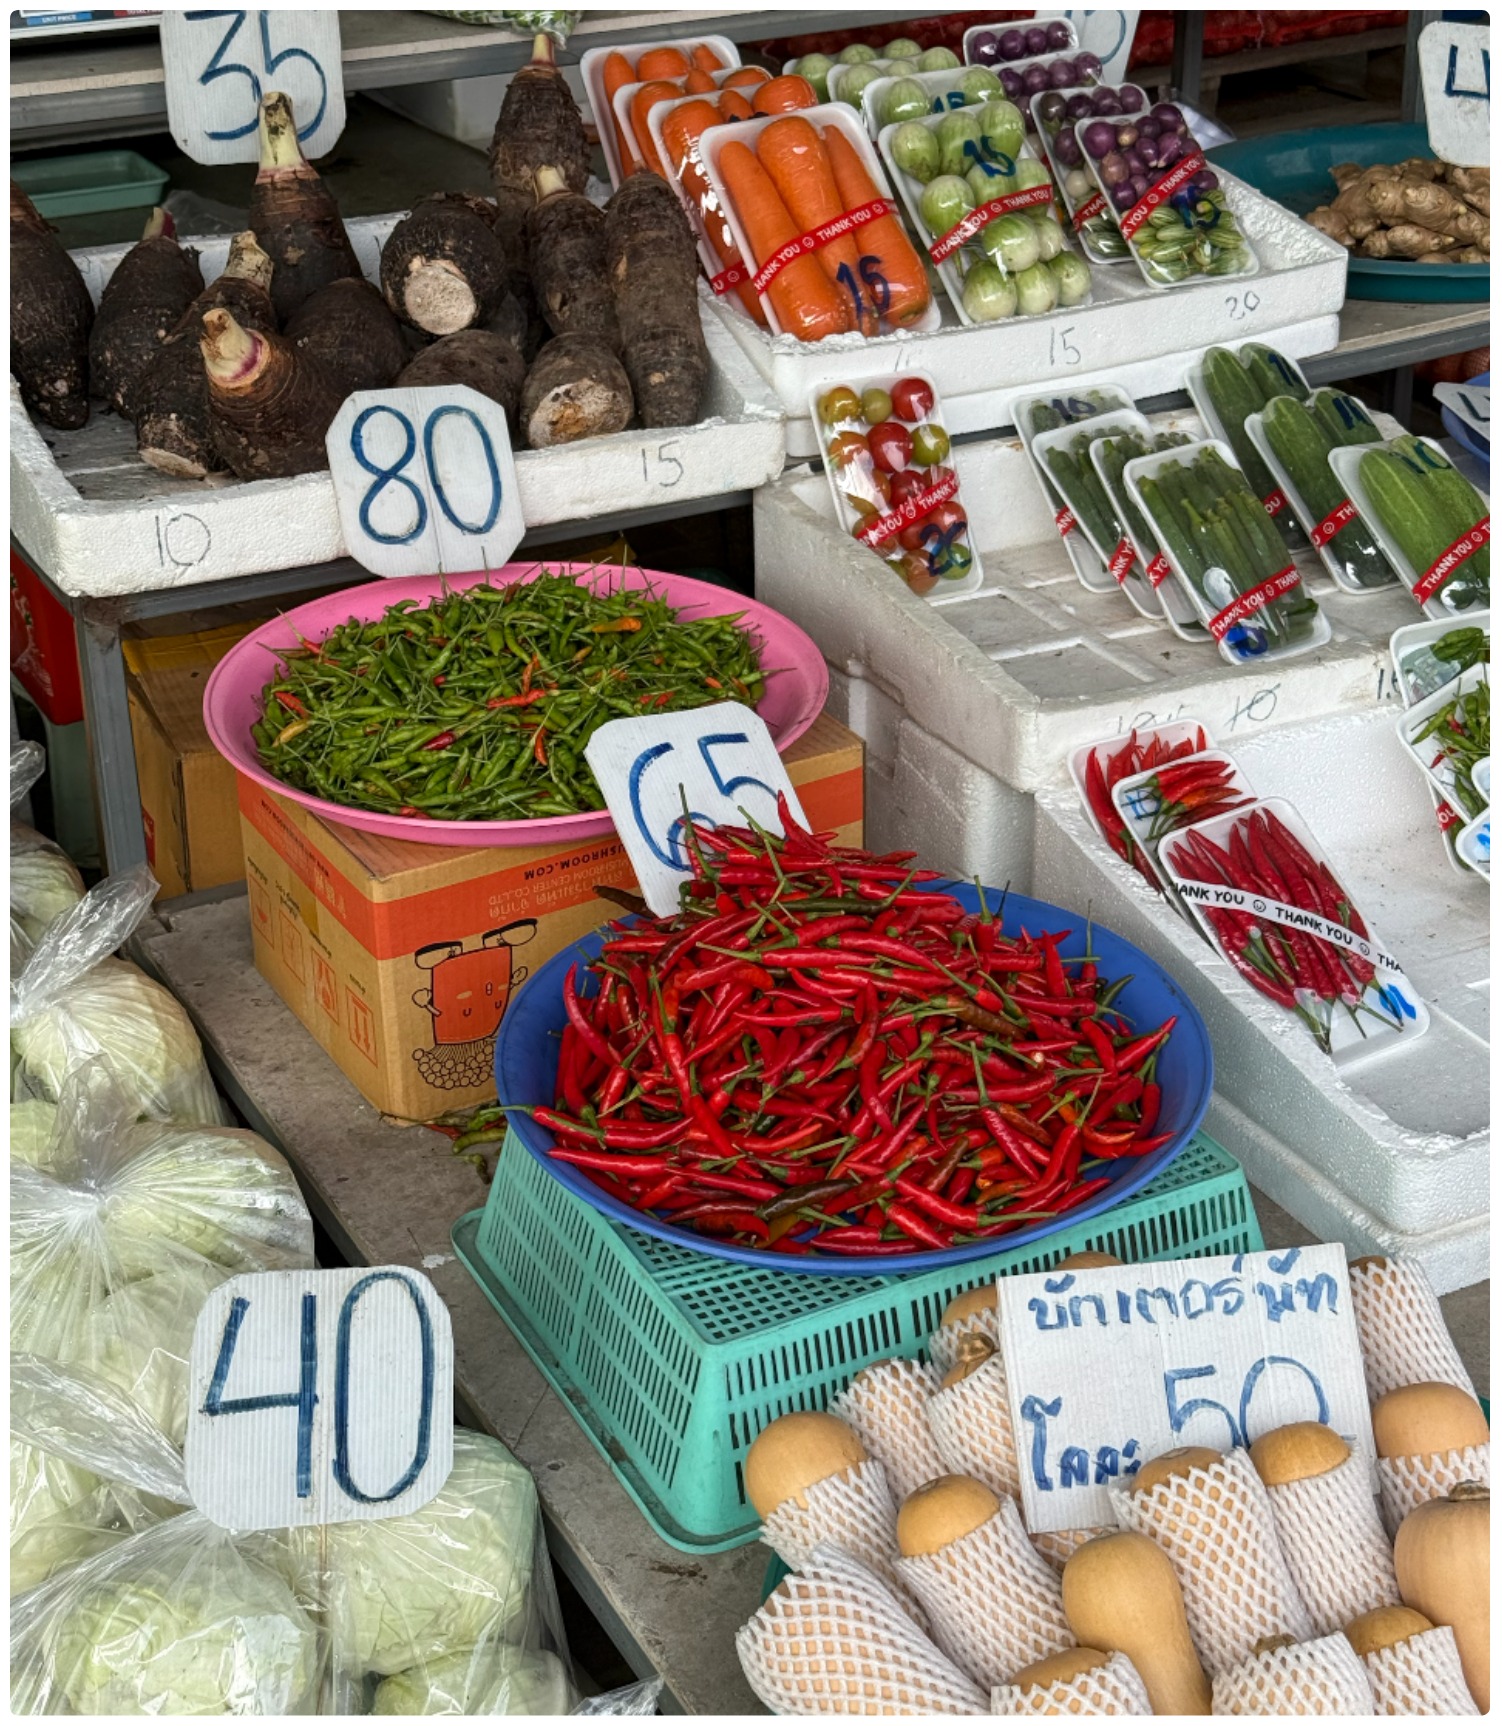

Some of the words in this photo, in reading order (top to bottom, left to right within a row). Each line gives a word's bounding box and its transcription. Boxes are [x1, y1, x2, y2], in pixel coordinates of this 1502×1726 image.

[184, 10, 328, 142] 35
[1032, 189, 1049, 201] YOU
[1130, 206, 1149, 227] YOU
[1159, 169, 1187, 193] THANK
[779, 244, 801, 263] YOU
[816, 218, 852, 242] THANK
[850, 209, 872, 227] YOU
[1226, 290, 1260, 319] 20
[1049, 327, 1081, 366] 15
[350, 404, 503, 545] 80
[642, 440, 685, 487] 15
[880, 516, 903, 537] YOU
[918, 483, 952, 511] THANK
[155, 512, 212, 567] 10
[1422, 557, 1459, 591] THANK
[1453, 540, 1473, 562] YOU
[1210, 605, 1244, 637] THANK
[1242, 590, 1265, 610] YOU
[629, 732, 783, 872] 65
[533, 875, 571, 893] CENTER
[1214, 890, 1245, 905] YOU
[1275, 906, 1323, 933] THANK
[1325, 923, 1354, 946] YOU
[199, 1270, 436, 1504] 40
[1163, 1355, 1331, 1450] 50
